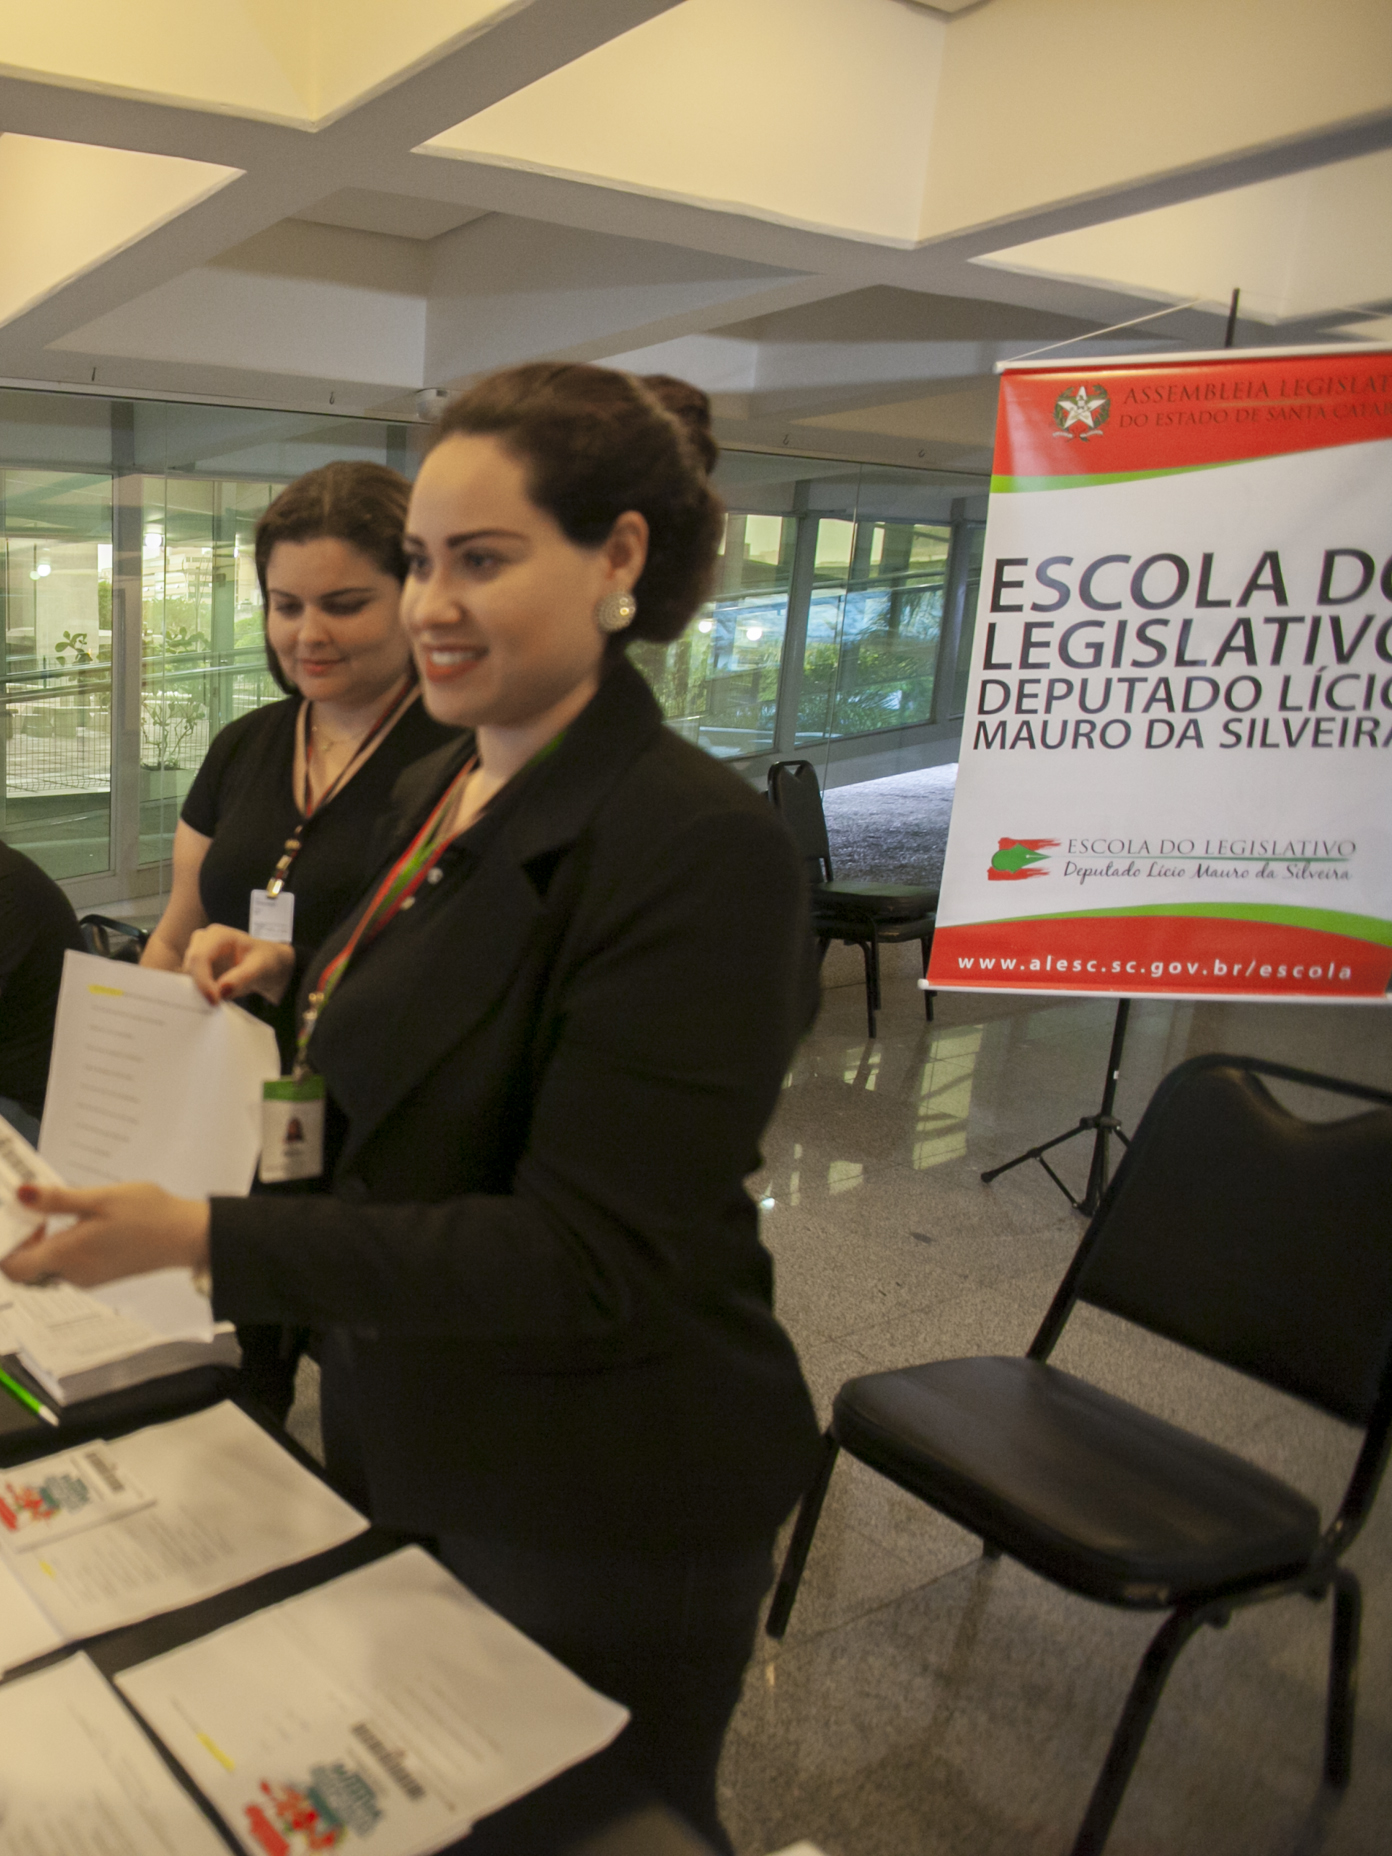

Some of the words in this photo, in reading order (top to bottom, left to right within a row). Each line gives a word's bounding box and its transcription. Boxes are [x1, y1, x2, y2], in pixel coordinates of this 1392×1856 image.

[1123, 380, 1269, 405] ASSEMBLEIA
[1119, 413, 1149, 428] DO
[1155, 409, 1228, 426] ESTADO
[1235, 407, 1257, 423] DE
[1266, 406, 1327, 421] SANTA
[989, 551, 1289, 613] ESCOLA
[1316, 548, 1392, 606] D
[976, 674, 1263, 715] DEPUTADO
[973, 718, 1132, 751] MAURO
[1145, 718, 1205, 749] DA
[1067, 838, 1150, 854] ESCOLA
[1160, 839, 1194, 855] DO
[1204, 839, 1357, 857] LEGISLATIVO
[1063, 860, 1141, 885] Deputado
[1190, 863, 1249, 879] Mauro
[1255, 861, 1277, 879] da
[1282, 861, 1352, 880] Silveira
[958, 955, 1352, 981] www.alesc.sc.gov.br/escola
